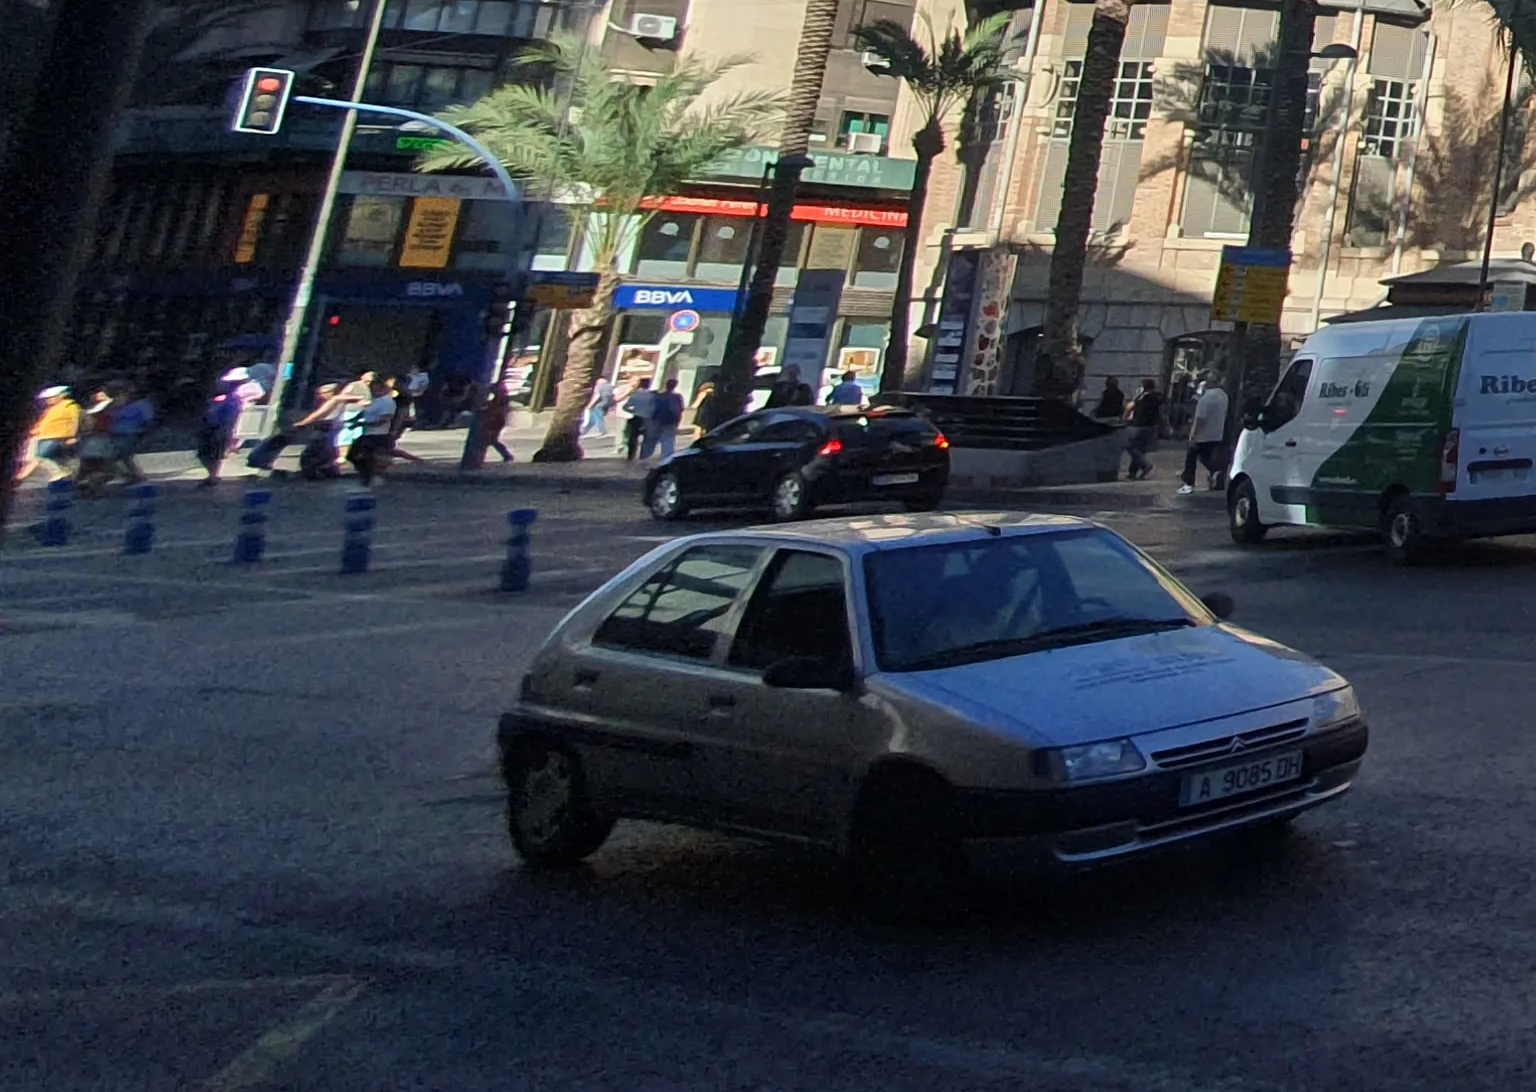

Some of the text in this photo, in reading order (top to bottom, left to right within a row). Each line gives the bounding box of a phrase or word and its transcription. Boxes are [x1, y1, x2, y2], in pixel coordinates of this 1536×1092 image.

[407, 282, 463, 297] BBVA
[635, 289, 693, 305] BBVA
[1199, 754, 1302, 798] A 9085 DH
